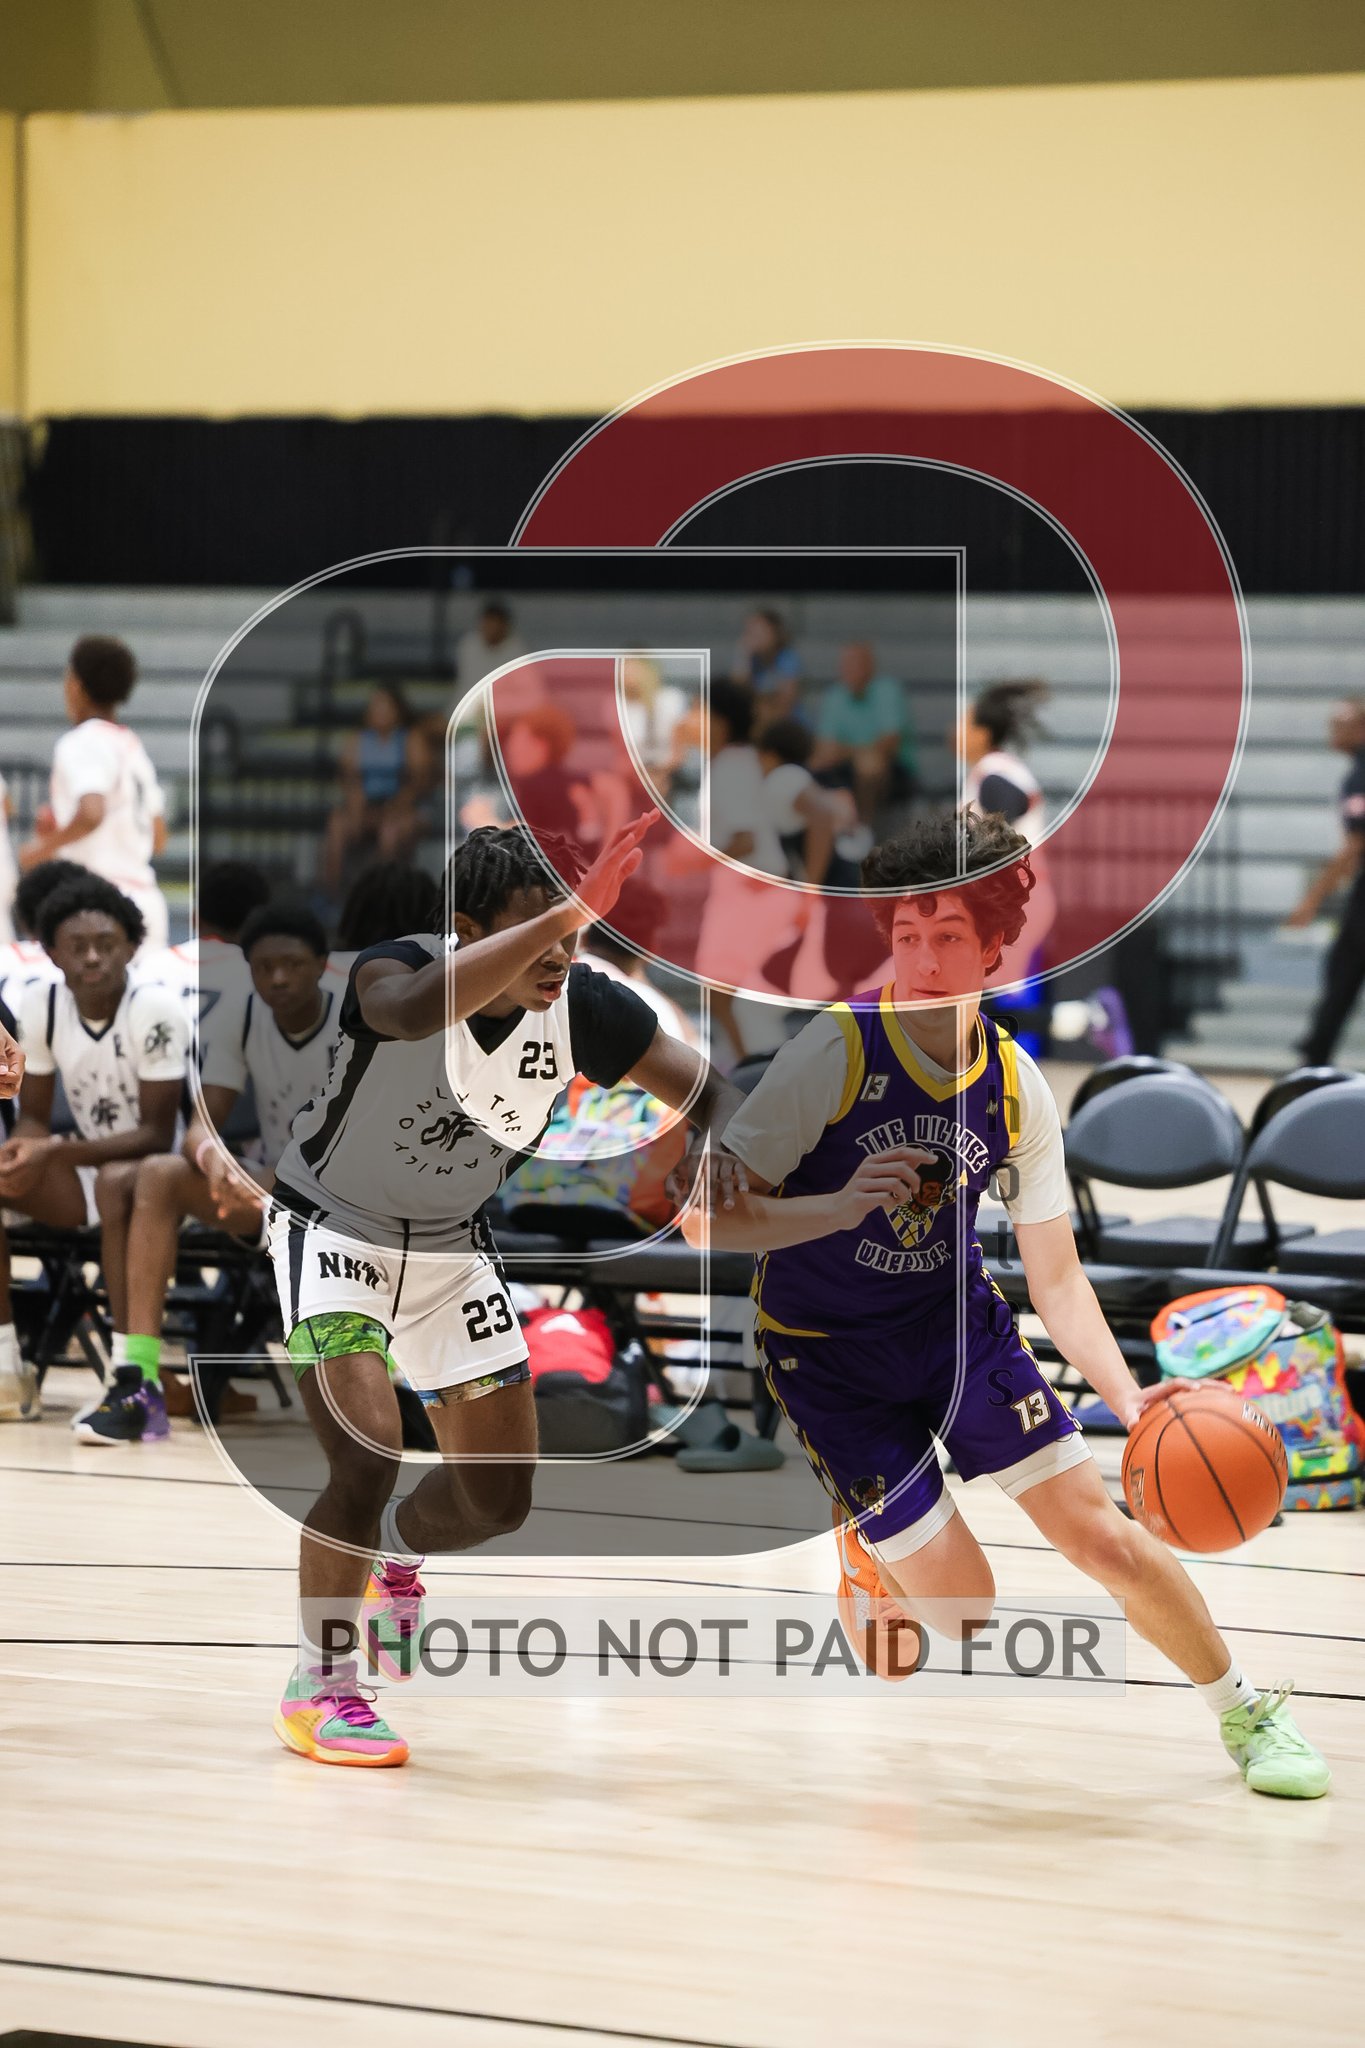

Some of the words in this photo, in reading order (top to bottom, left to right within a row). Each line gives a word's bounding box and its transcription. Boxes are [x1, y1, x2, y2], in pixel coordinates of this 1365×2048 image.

[518, 1040, 559, 1080] 23
[859, 1073, 891, 1101] 13
[488, 1094, 522, 1132] THE
[855, 1117, 907, 1156] THE
[461, 1292, 515, 1343] 23
[1010, 1388, 1052, 1435] 13
